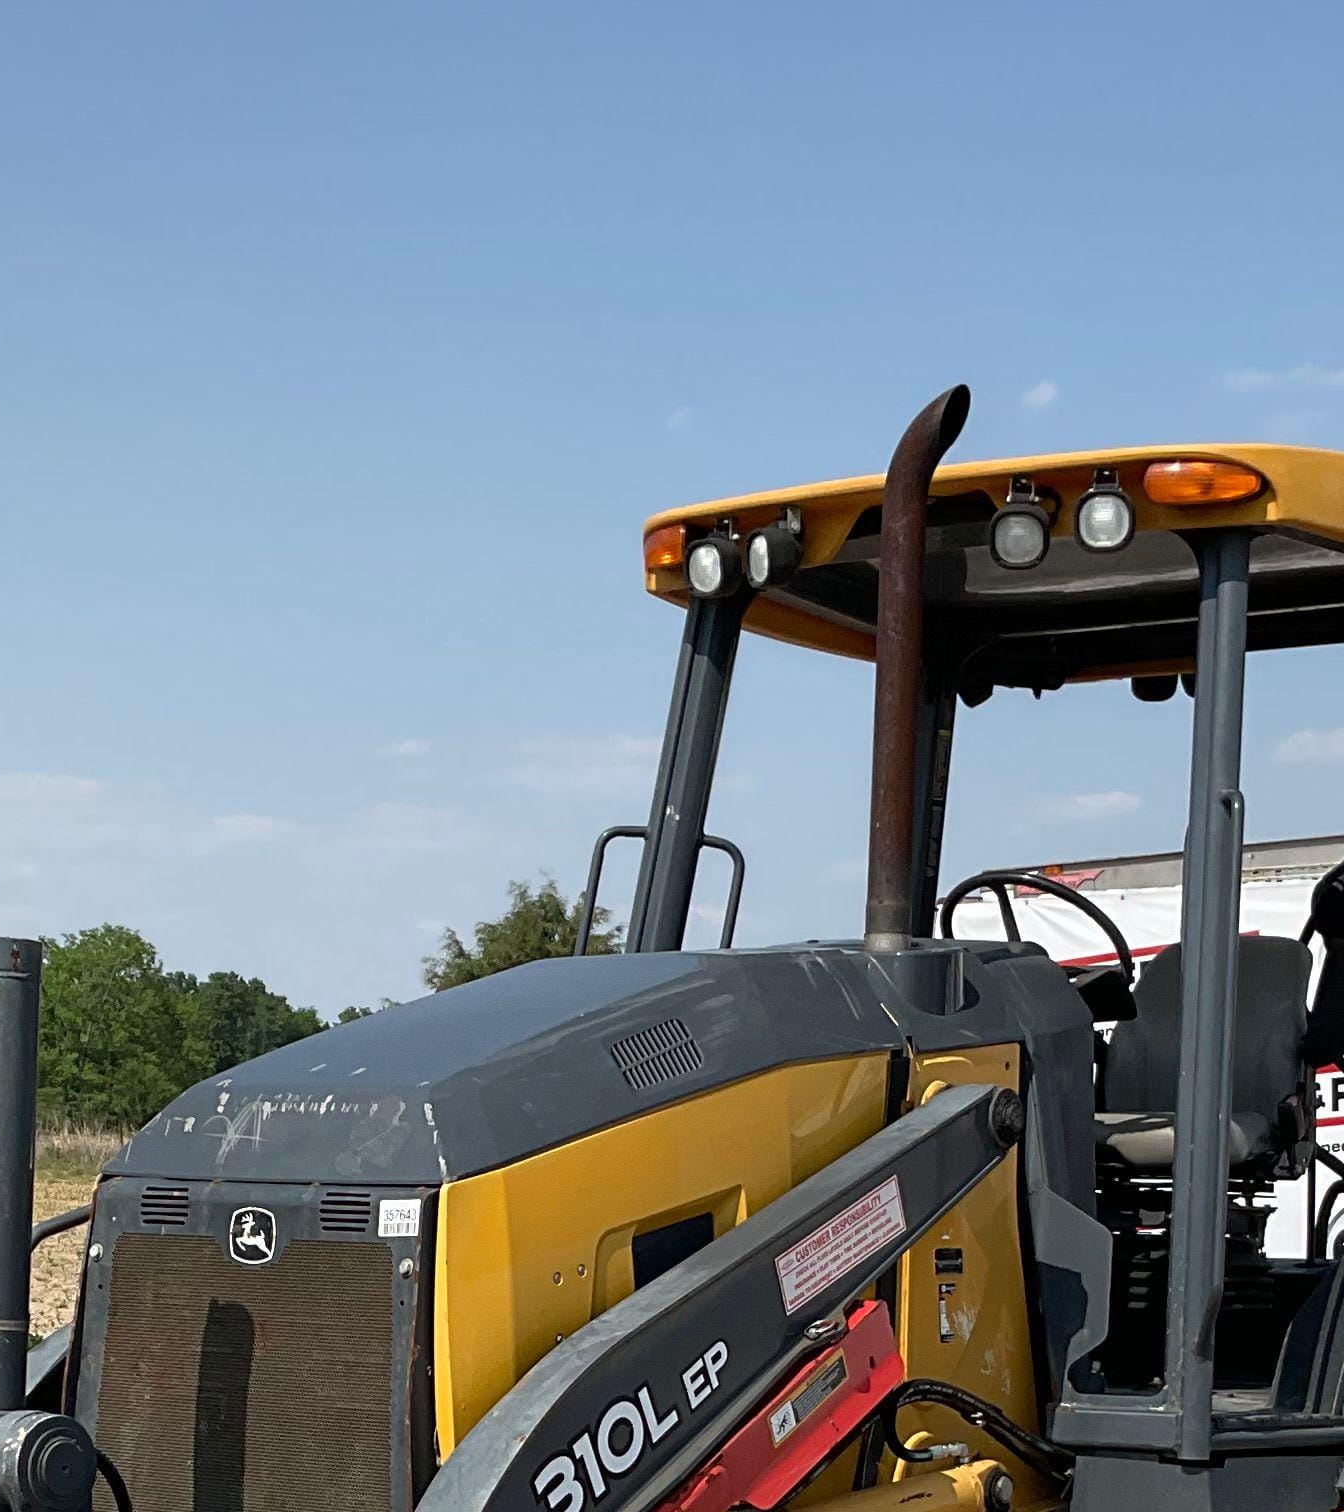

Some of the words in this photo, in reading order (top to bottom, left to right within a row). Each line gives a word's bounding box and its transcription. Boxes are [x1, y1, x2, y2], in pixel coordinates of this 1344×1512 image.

[795, 1230, 831, 1263] CUSTOMER
[831, 1194, 881, 1238] RESPONSIBILITY
[682, 1341, 728, 1410] EP
